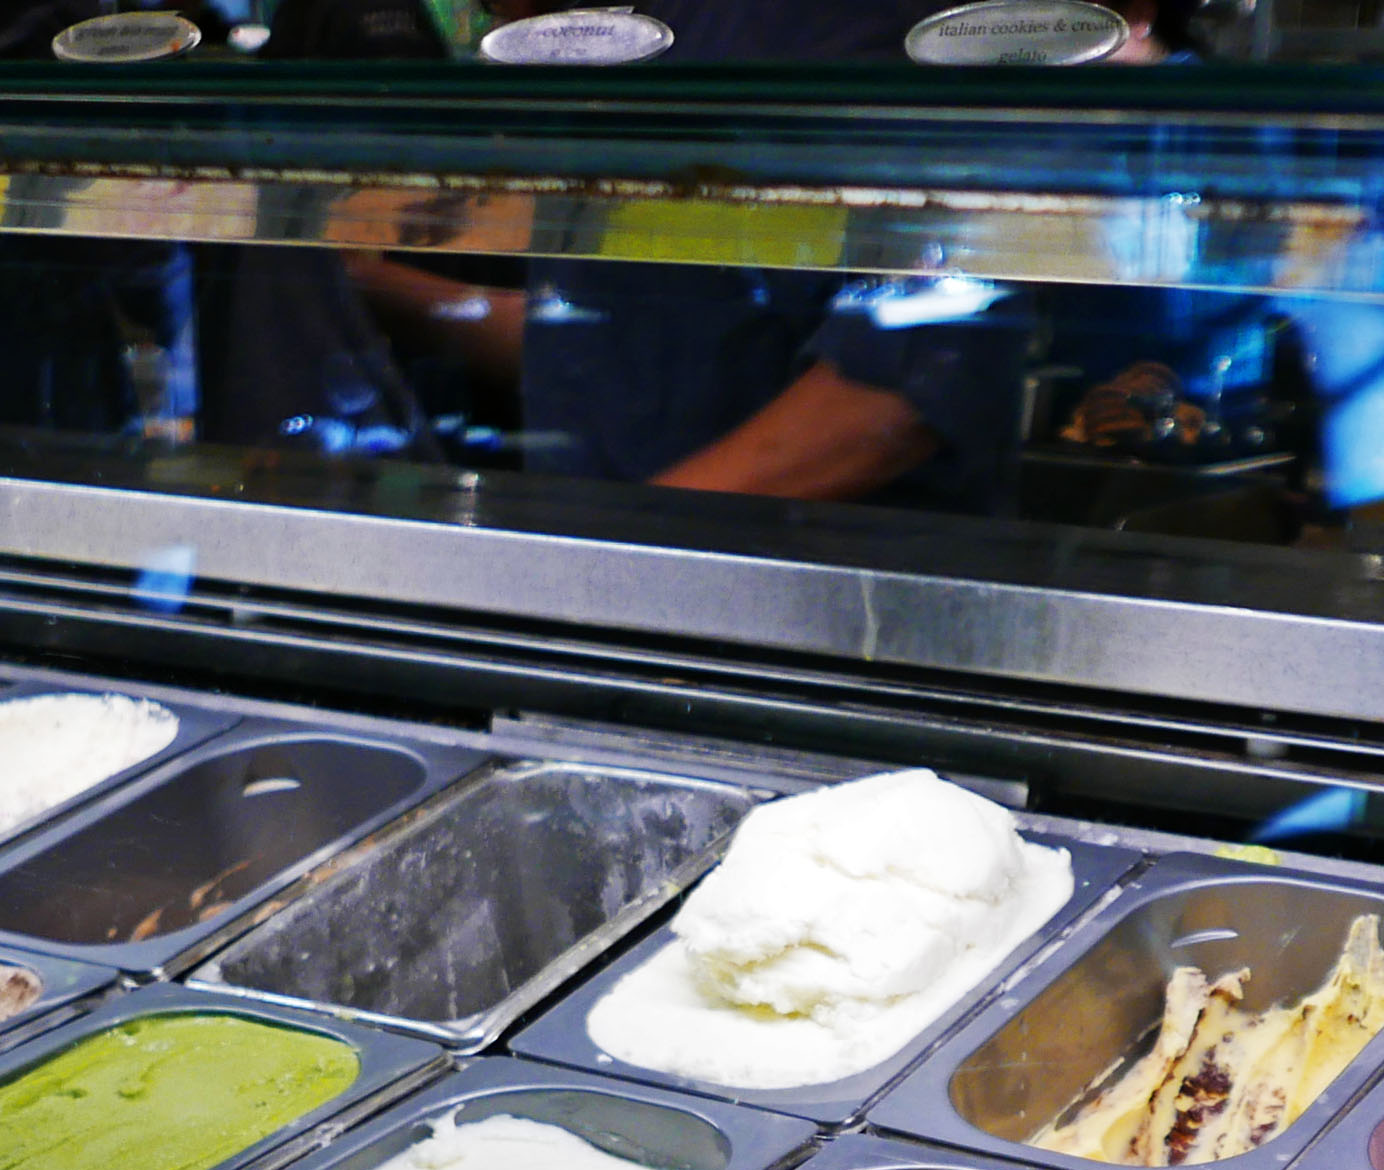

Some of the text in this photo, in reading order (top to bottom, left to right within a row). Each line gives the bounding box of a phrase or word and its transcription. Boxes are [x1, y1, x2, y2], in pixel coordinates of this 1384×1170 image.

[937, 21, 988, 37] italian
[990, 19, 1049, 36] cookies
[1052, 18, 1066, 33] &
[998, 48, 1048, 65] gelato
